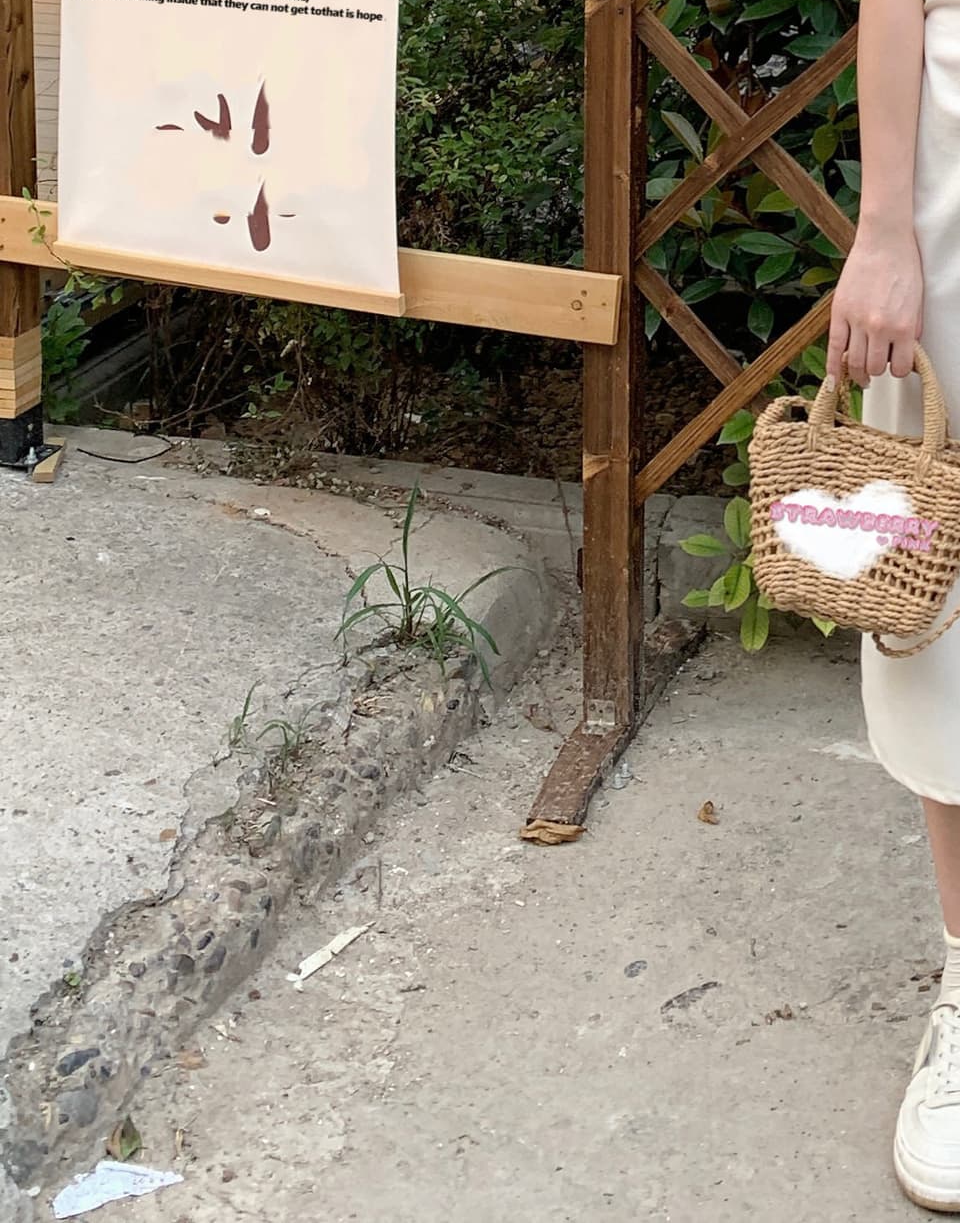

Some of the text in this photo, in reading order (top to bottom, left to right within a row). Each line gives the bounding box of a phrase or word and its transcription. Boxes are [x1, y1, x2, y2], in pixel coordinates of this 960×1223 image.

[250, 2, 269, 12] can
[270, 3, 289, 13] not
[290, 5, 309, 16] get
[311, 6, 344, 19] tothat
[345, 8, 355, 19] is
[356, 9, 383, 23] hope
[770, 501, 939, 538] STRAWBERRY
[891, 535, 933, 551] PINK
